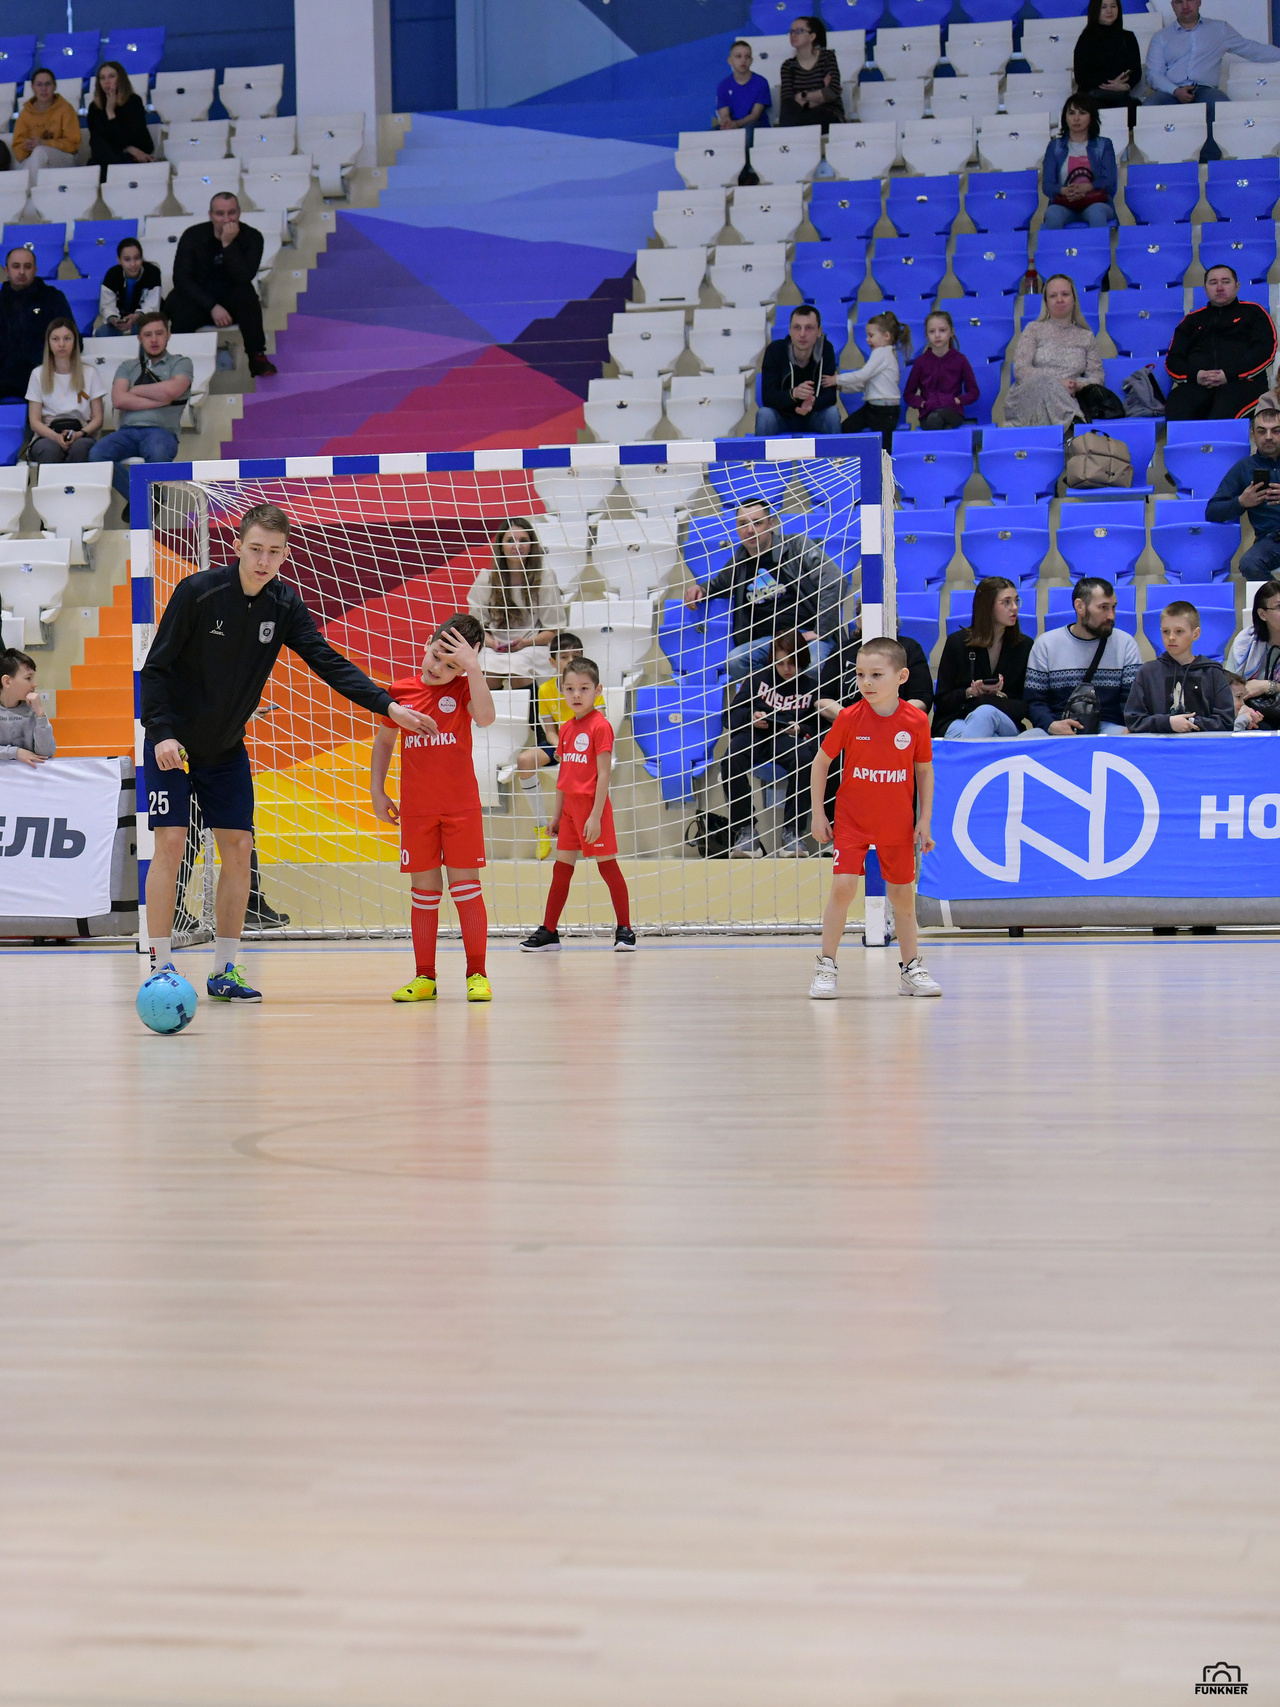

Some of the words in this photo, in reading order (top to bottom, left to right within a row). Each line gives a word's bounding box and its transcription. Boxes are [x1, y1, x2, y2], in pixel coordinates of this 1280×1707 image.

[757, 681, 813, 711] RUSSIA
[404, 732, 457, 749] АРКТИКА
[148, 790, 170, 815] 25
